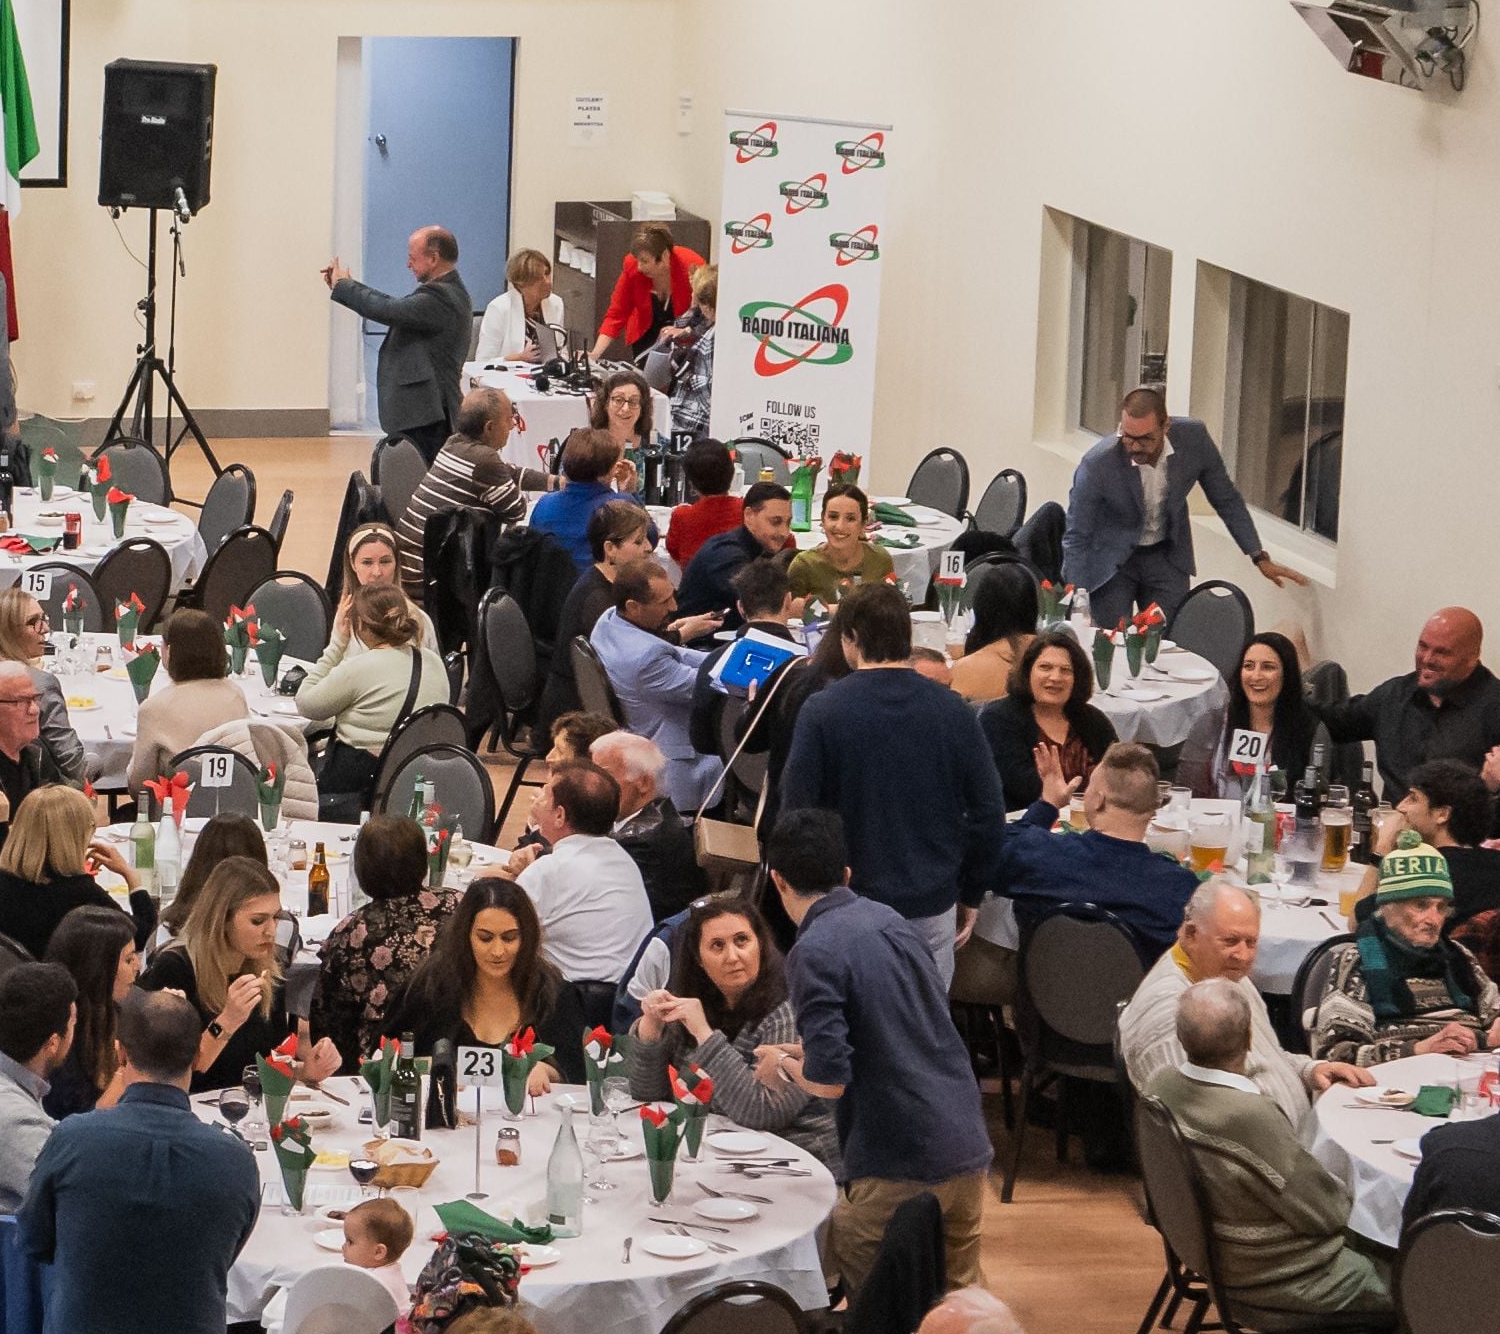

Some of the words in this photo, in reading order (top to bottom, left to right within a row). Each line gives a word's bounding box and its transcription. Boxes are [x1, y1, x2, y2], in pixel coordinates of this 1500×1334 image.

[742, 316, 784, 338] RADIO
[787, 322, 850, 345] ITALIANA
[766, 400, 802, 417] FOLLOW
[804, 405, 817, 419] US
[675, 435, 692, 452] 12
[945, 556, 961, 574] 16
[28, 573, 48, 593] 15
[1237, 733, 1261, 758] 20
[208, 756, 229, 779] 19
[463, 1051, 495, 1077] 23
